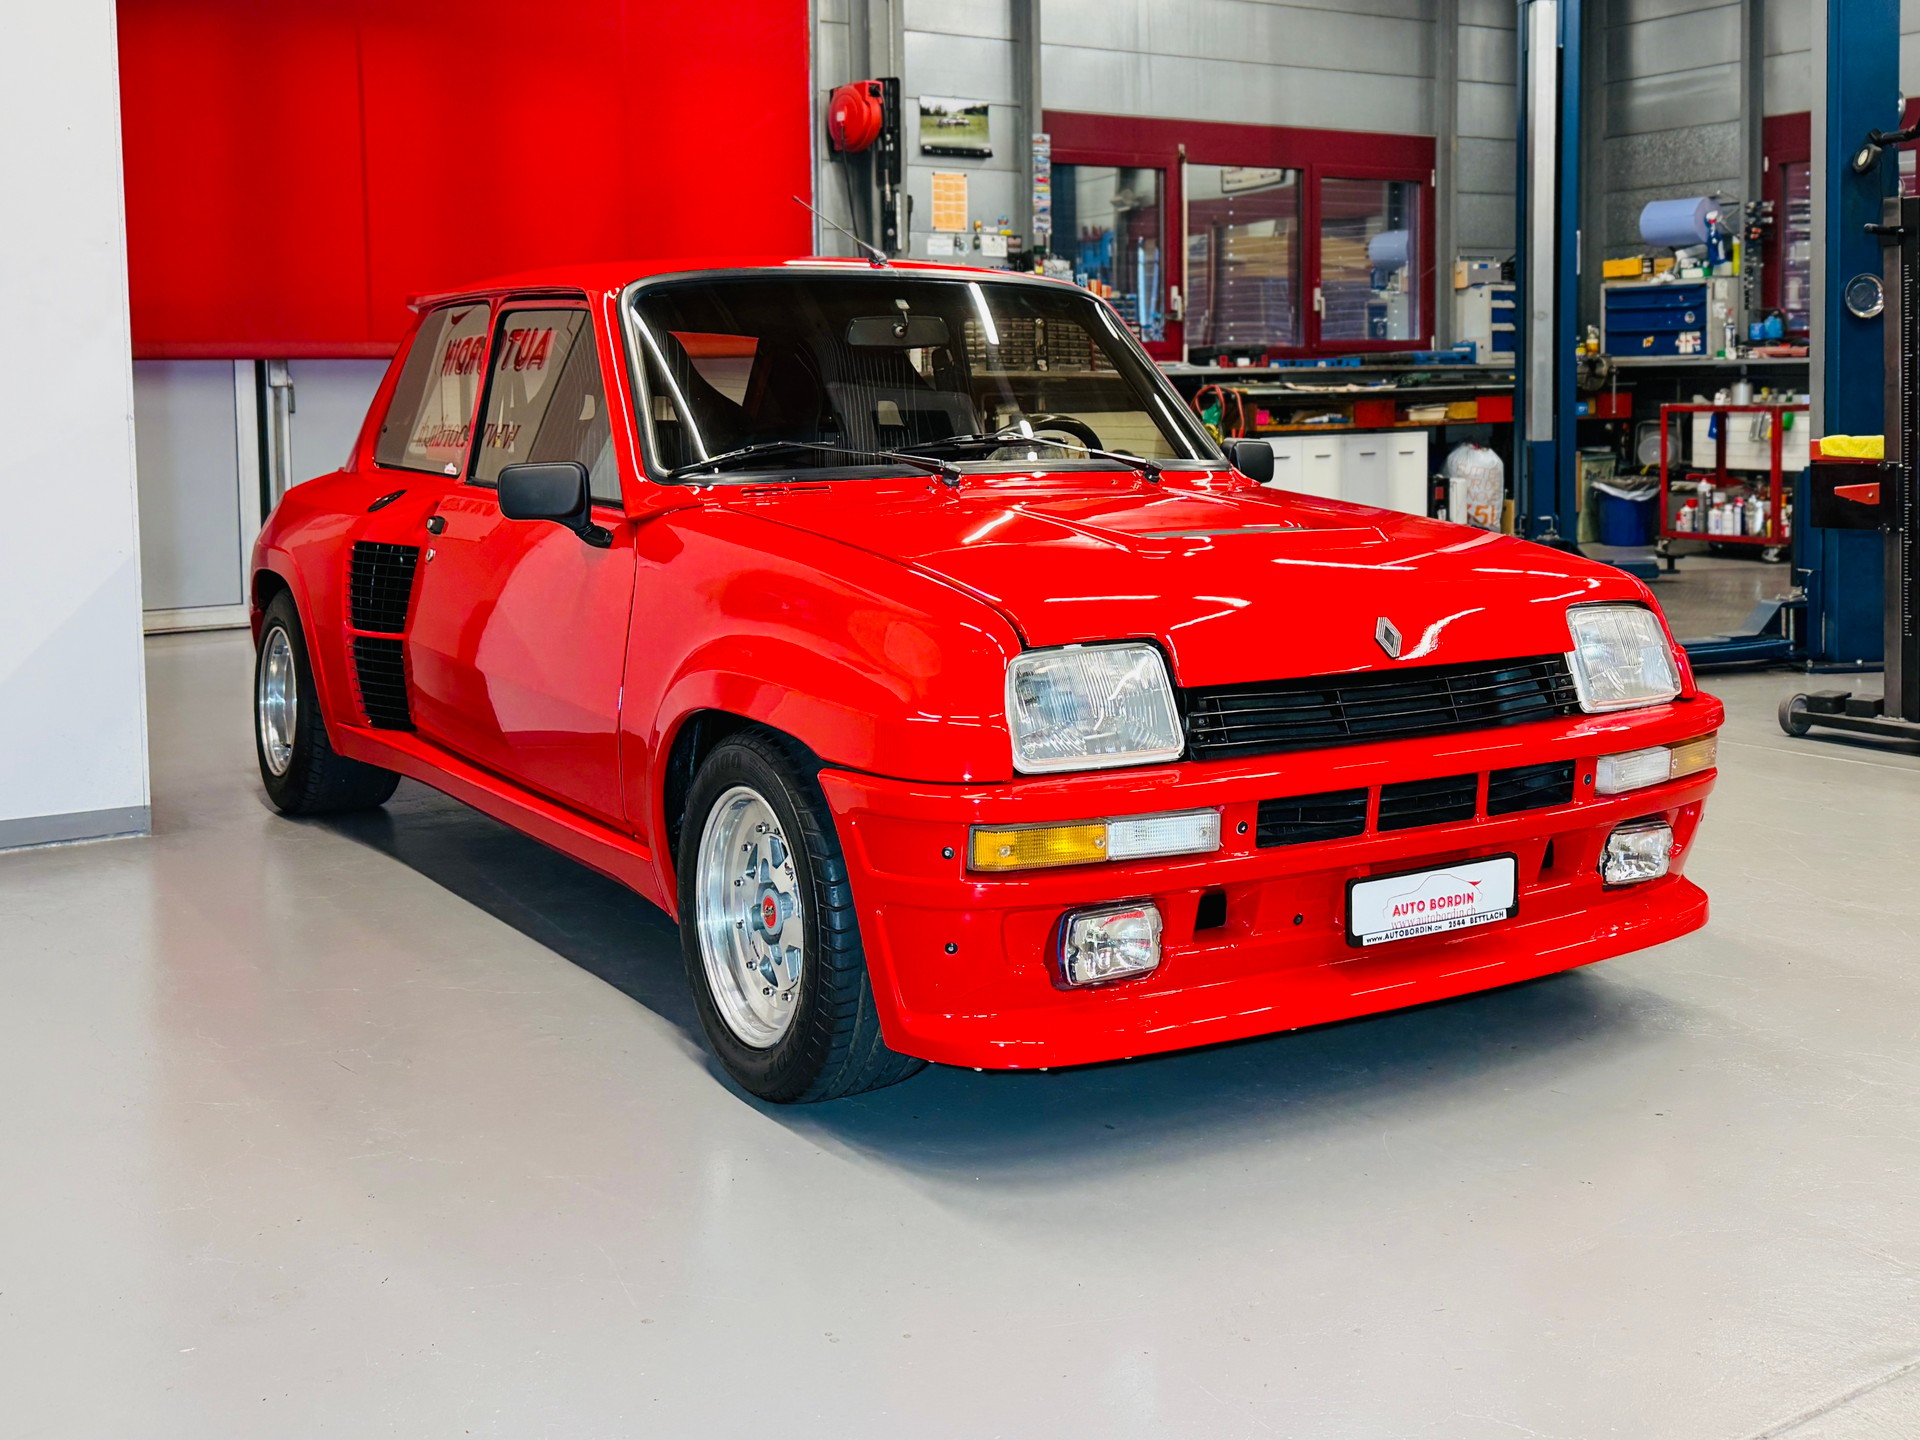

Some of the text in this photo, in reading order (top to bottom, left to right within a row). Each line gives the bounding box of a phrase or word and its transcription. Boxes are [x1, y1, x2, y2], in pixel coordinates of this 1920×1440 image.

[1392, 892, 1475, 917] AUTO BORDIN
[1390, 905, 1477, 930] www.autobordin.ch
[1448, 919, 1466, 929] 2544
[1469, 911, 1504, 925] BETTLACH
